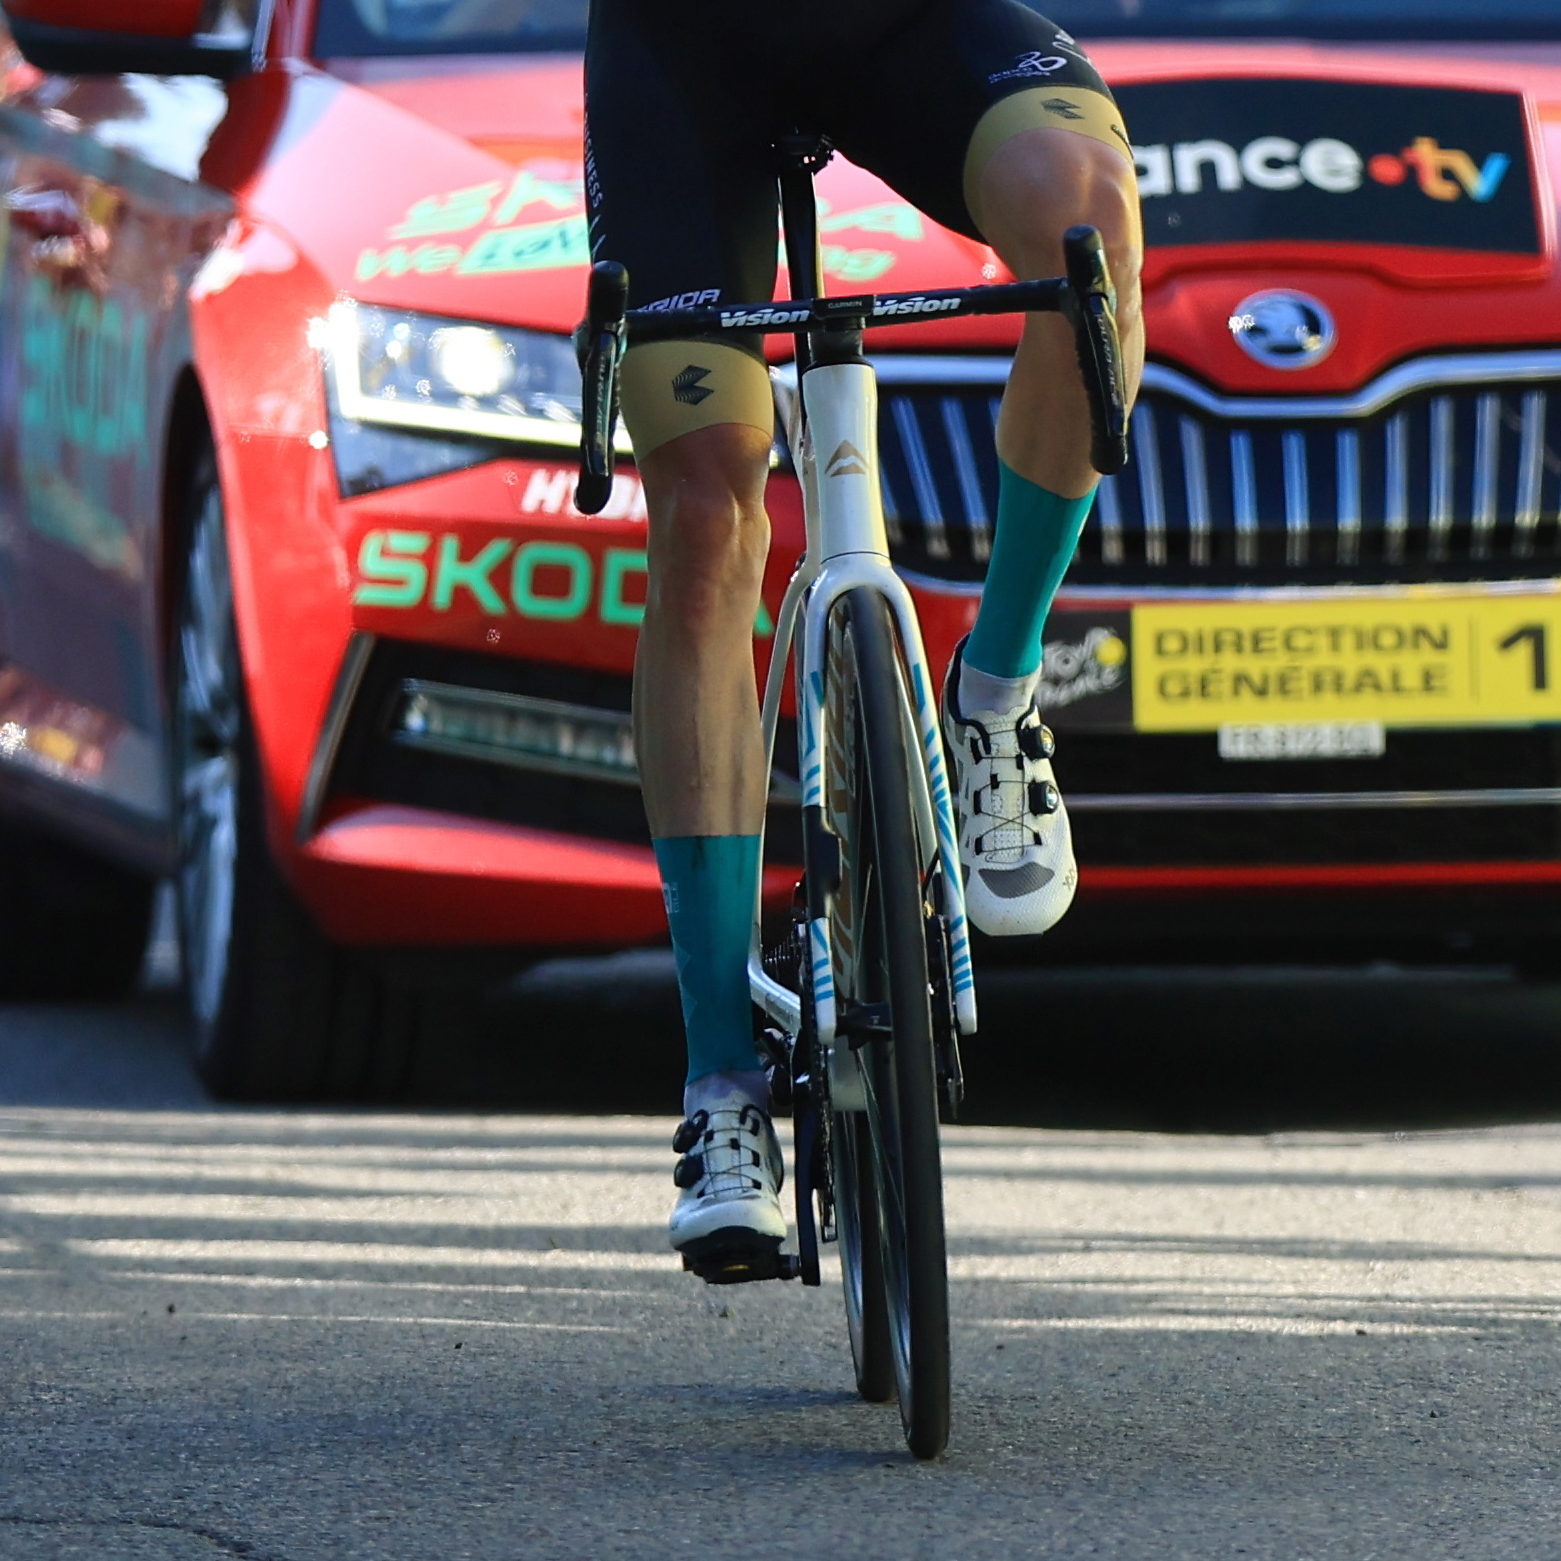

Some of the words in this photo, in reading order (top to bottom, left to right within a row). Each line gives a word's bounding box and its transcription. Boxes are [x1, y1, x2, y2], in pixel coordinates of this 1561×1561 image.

[720, 308, 810, 328] Vision
[827, 300, 863, 310] GARMIN
[873, 296, 961, 316] Vision
[1155, 623, 1449, 659] DIRECTION
[1496, 623, 1552, 692] 1
[1156, 662, 1448, 702] GÉNÉRALE
